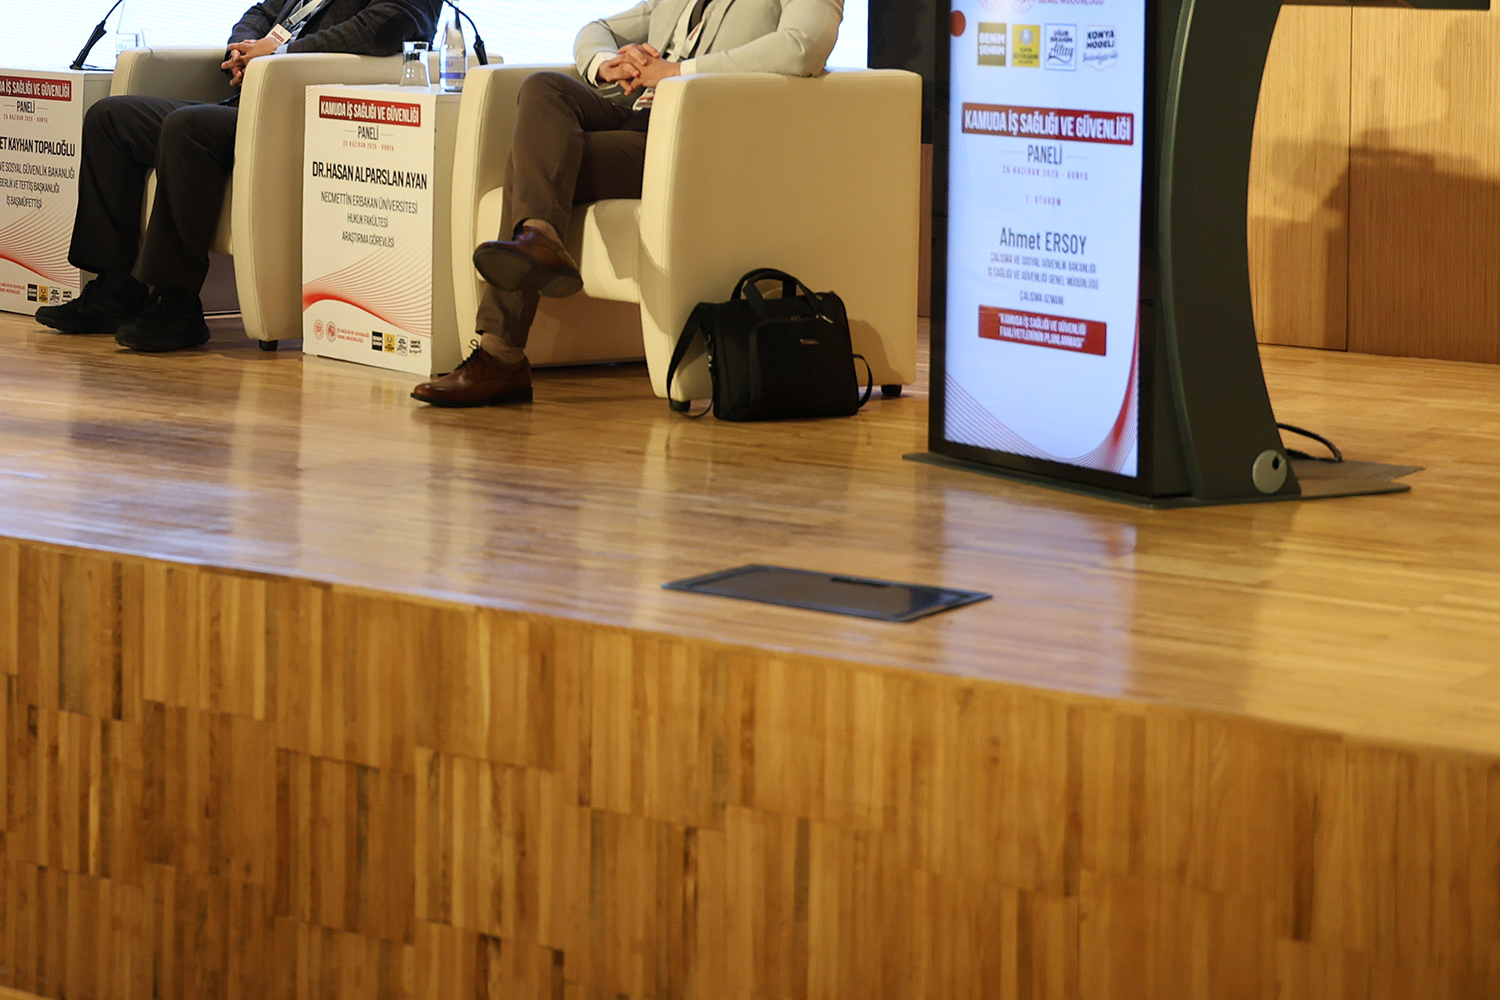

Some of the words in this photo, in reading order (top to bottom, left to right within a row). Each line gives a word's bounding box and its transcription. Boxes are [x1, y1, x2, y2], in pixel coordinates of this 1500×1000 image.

[1087, 30, 1114, 39] KONYA
[6, 79, 11, 95] İŞ
[12, 81, 33, 94] SAĞLIĞI
[34, 84, 40, 95] VE
[41, 82, 69, 97] GÜVENLİĞİ
[17, 100, 35, 113] PANELİ
[321, 101, 346, 116] KAMUDA
[347, 101, 353, 119] İŞ
[354, 103, 376, 119] SAĞLIĞI
[378, 107, 385, 120] VE
[387, 106, 419, 123] GÜVENLİĞİ
[358, 126, 379, 140] PANELİ
[965, 110, 1007, 131] KAMUDA
[1008, 110, 1018, 135] İŞ
[1020, 111, 1059, 135] SAĞLIĞI
[1060, 116, 1074, 136] VE
[1076, 115, 1131, 140] GÜVENLİĞİ
[8, 138, 33, 152] KAYHAN
[35, 140, 75, 156] TOPALOĞLU
[1027, 144, 1062, 164] PANELİ
[313, 161, 354, 181] DR.HASAN
[355, 167, 404, 187] ALPARSLAN
[405, 171, 427, 189] AYAN
[1000, 227, 1040, 250] Ahmet
[1045, 232, 1087, 255] ERSOY
